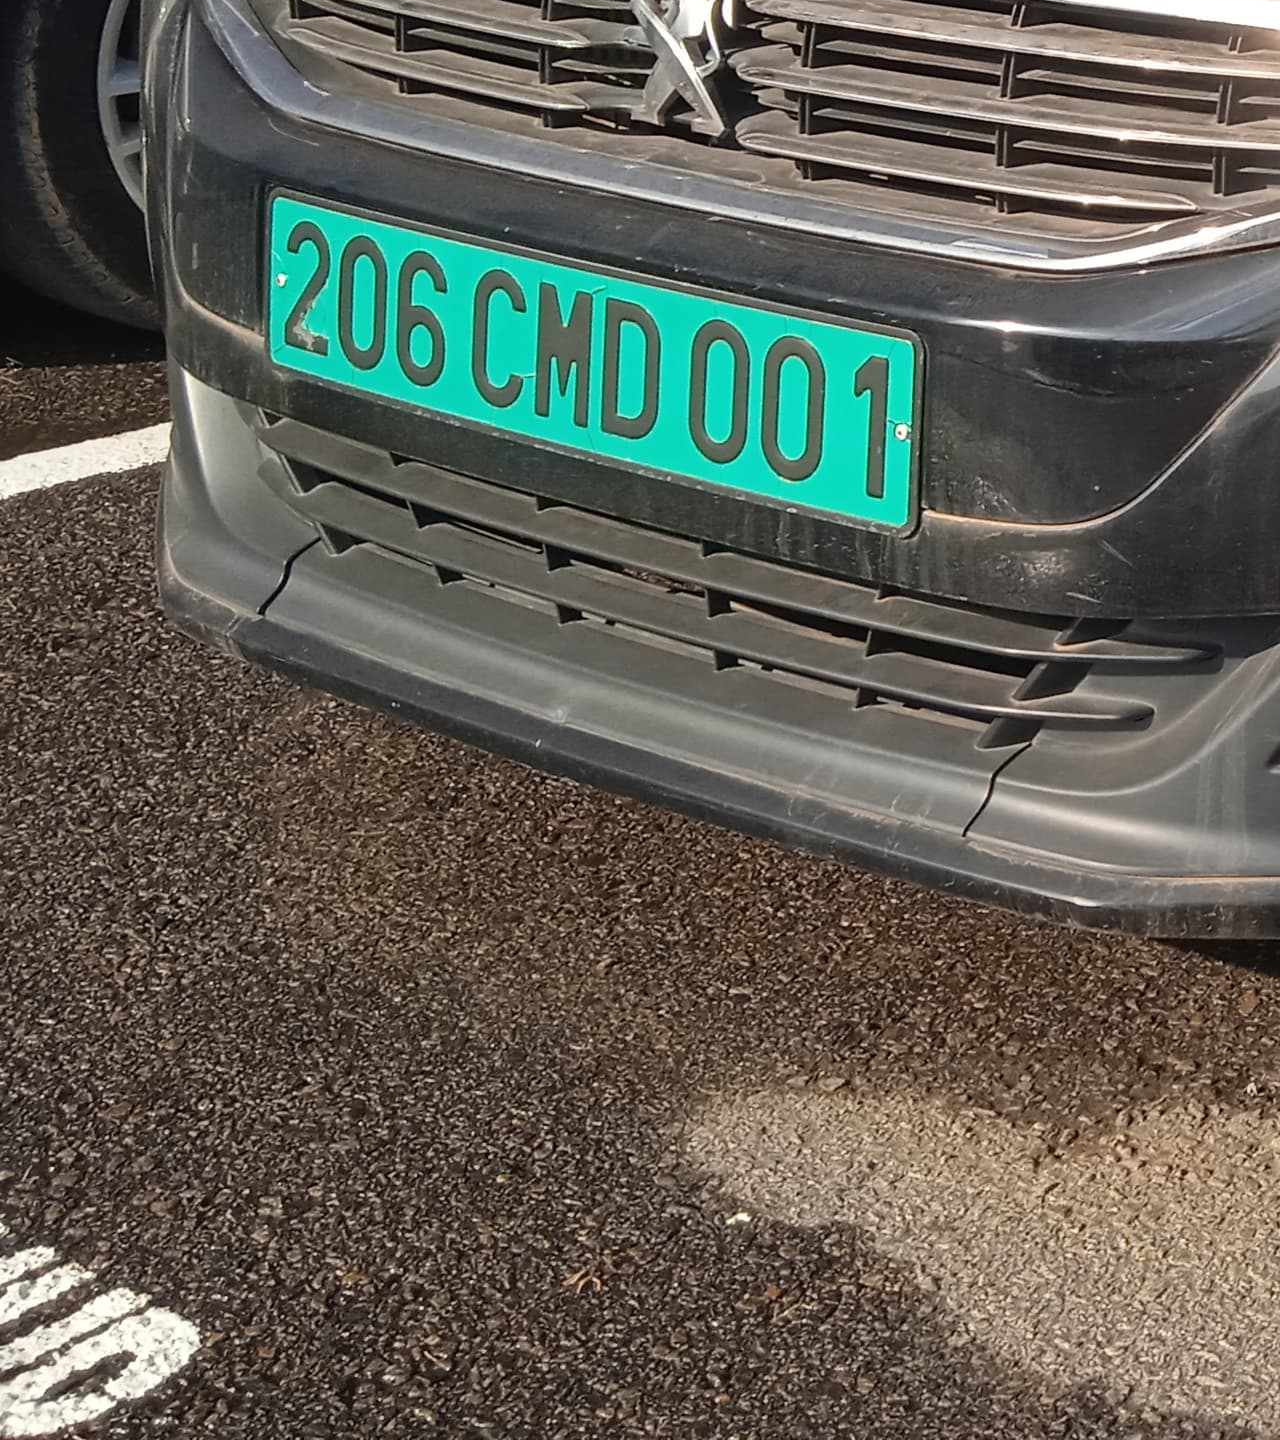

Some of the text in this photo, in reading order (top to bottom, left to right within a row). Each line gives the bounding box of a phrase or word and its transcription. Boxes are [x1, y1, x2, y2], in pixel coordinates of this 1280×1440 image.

[284, 220, 890, 500] 206 CMD 001
